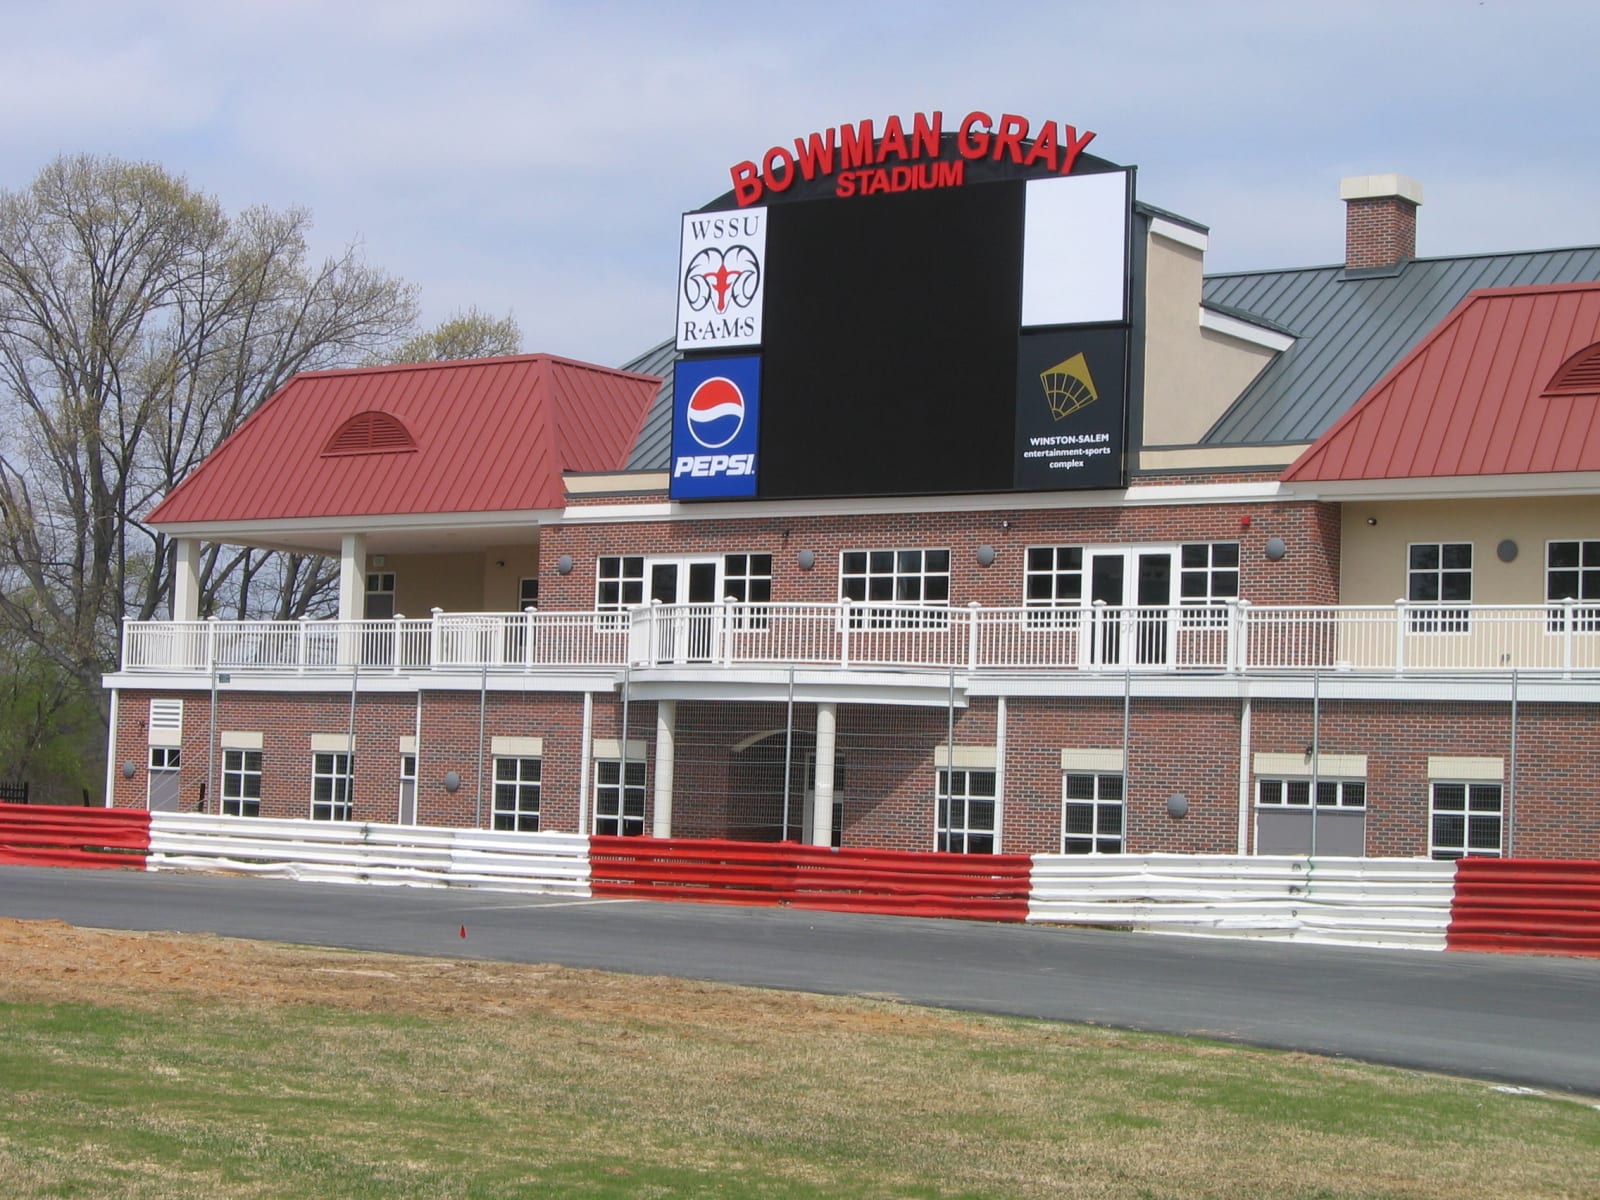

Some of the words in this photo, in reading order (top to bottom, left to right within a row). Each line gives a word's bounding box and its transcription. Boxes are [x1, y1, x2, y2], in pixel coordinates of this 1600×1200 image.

[730, 111, 943, 207] BOWMAN
[957, 111, 1097, 174] GRAY
[836, 160, 965, 198] STADIUM
[690, 215, 760, 241] WSSU
[1030, 433, 1110, 446] WINSTON-SALEM
[1023, 447, 1111, 458] entertainment-sports
[1049, 459, 1084, 470] complex
[673, 453, 755, 477] PEPSI
